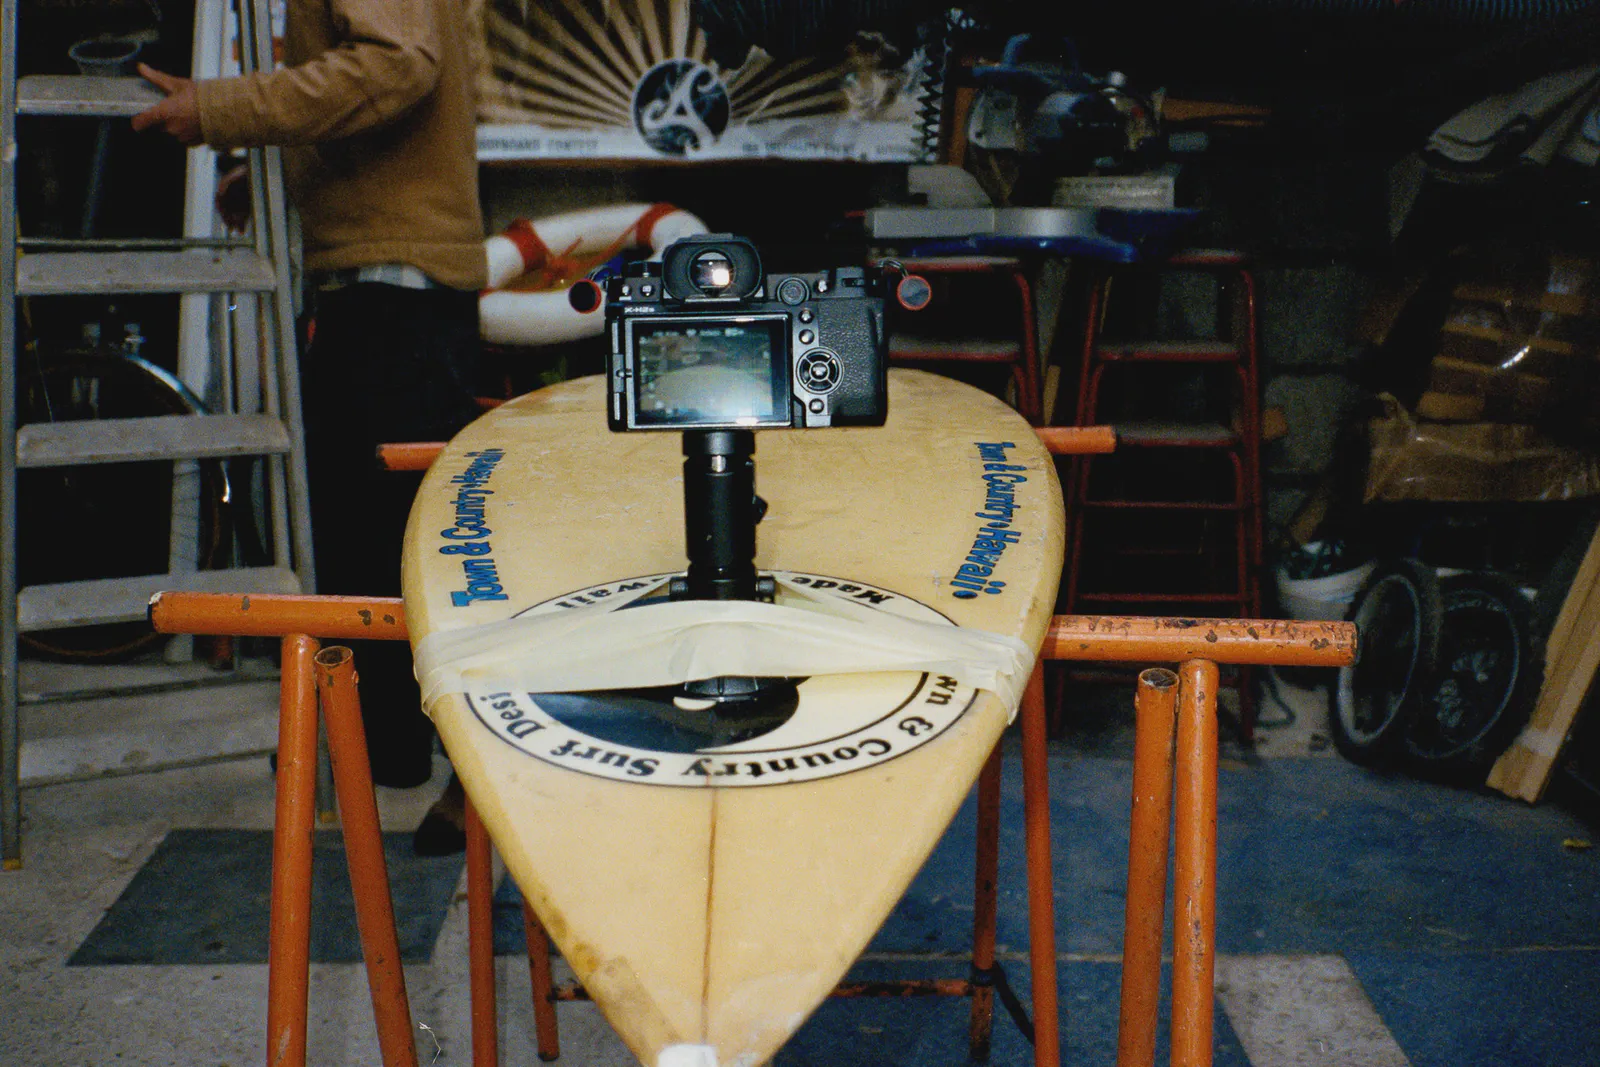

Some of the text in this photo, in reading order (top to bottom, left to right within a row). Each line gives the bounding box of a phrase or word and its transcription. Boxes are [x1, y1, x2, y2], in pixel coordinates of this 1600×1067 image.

[974, 441, 1017, 462] Town
[983, 463, 1029, 473] &
[438, 541, 493, 556] &
[450, 558, 509, 607] Town
[790, 576, 895, 605] Made
[479, 690, 547, 741] Desi
[897, 716, 935, 737] &
[549, 739, 661, 777] Surf
[680, 737, 893, 778] Country
